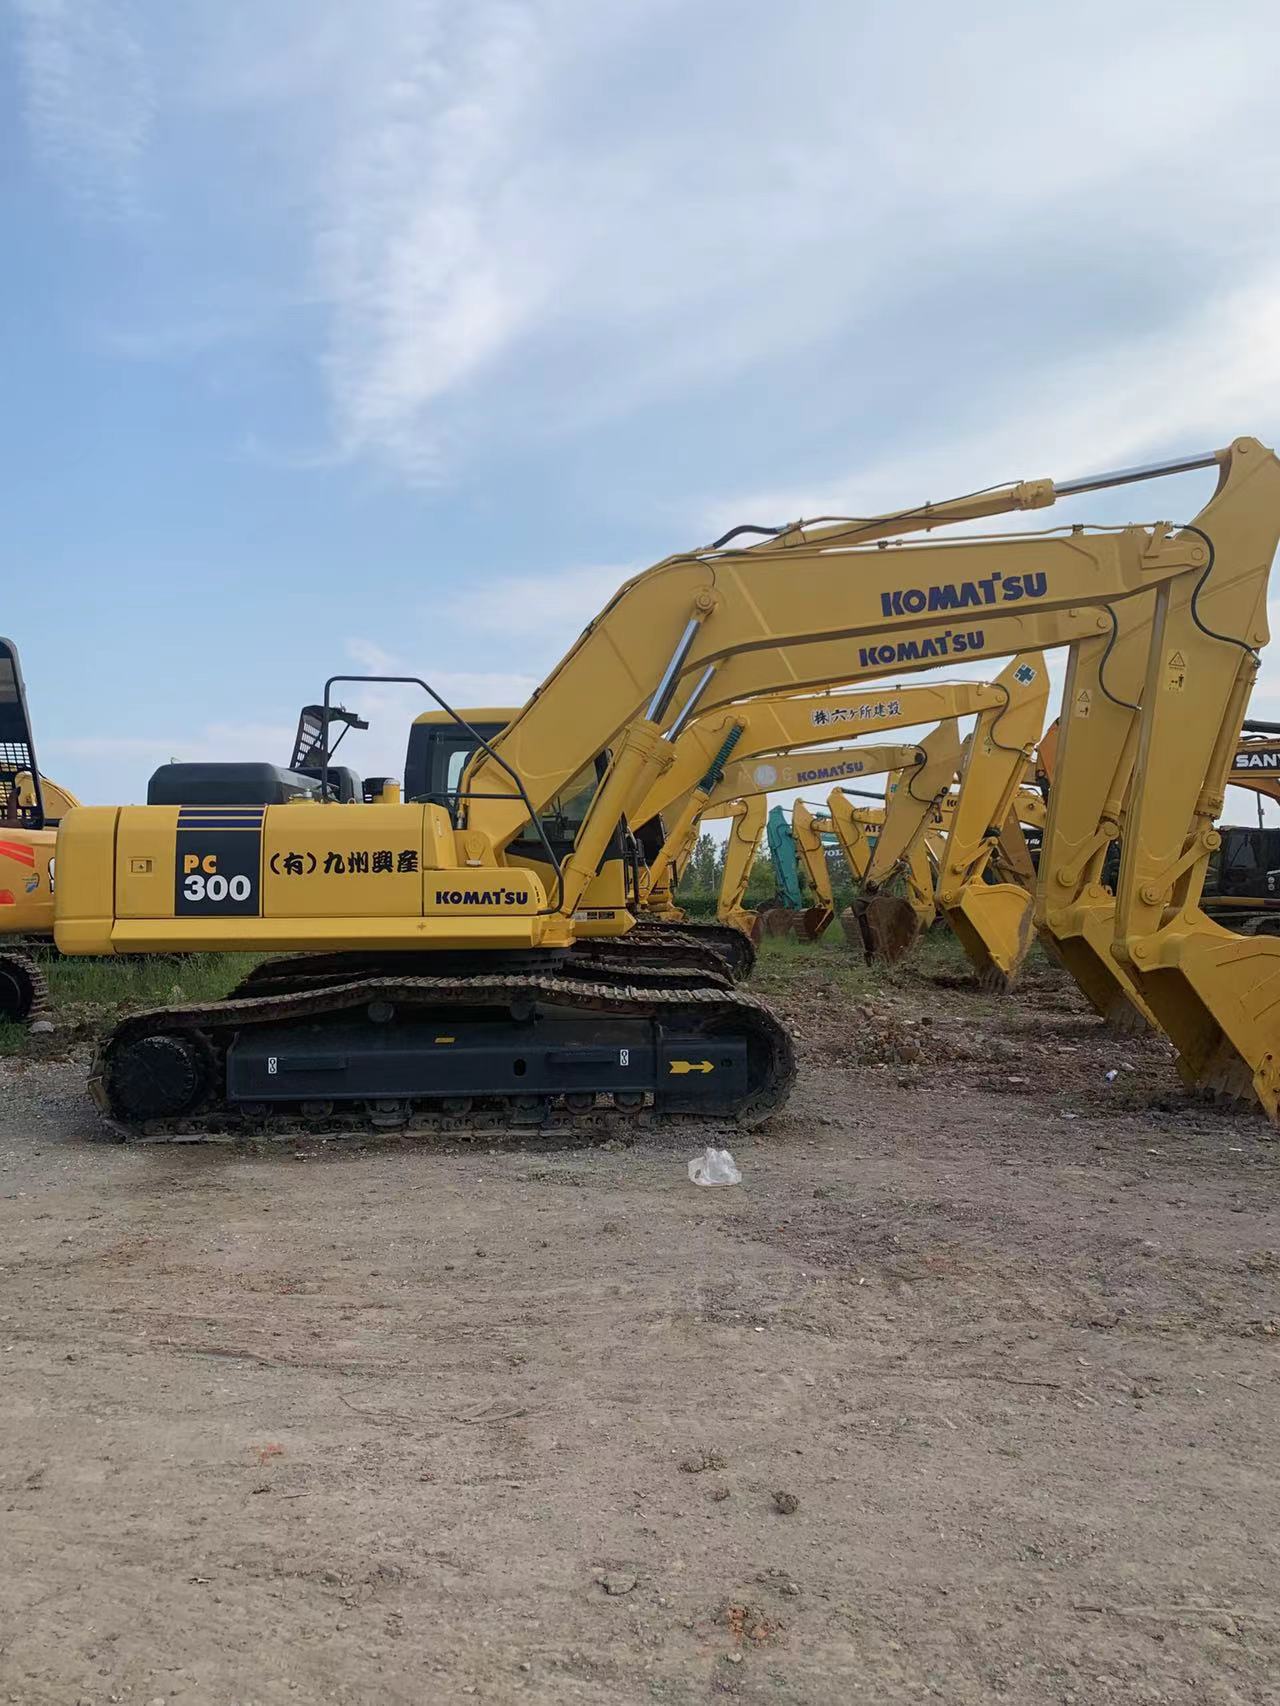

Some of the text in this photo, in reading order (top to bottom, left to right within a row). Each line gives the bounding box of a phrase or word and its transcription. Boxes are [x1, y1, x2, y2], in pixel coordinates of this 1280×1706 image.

[881, 572, 1048, 617] KOMATSU
[859, 631, 985, 667] KOMATSU
[797, 761, 864, 783] KOMATSU
[184, 855, 217, 874] PC
[184, 875, 251, 901] 300
[436, 888, 528, 905] KOMATSU
